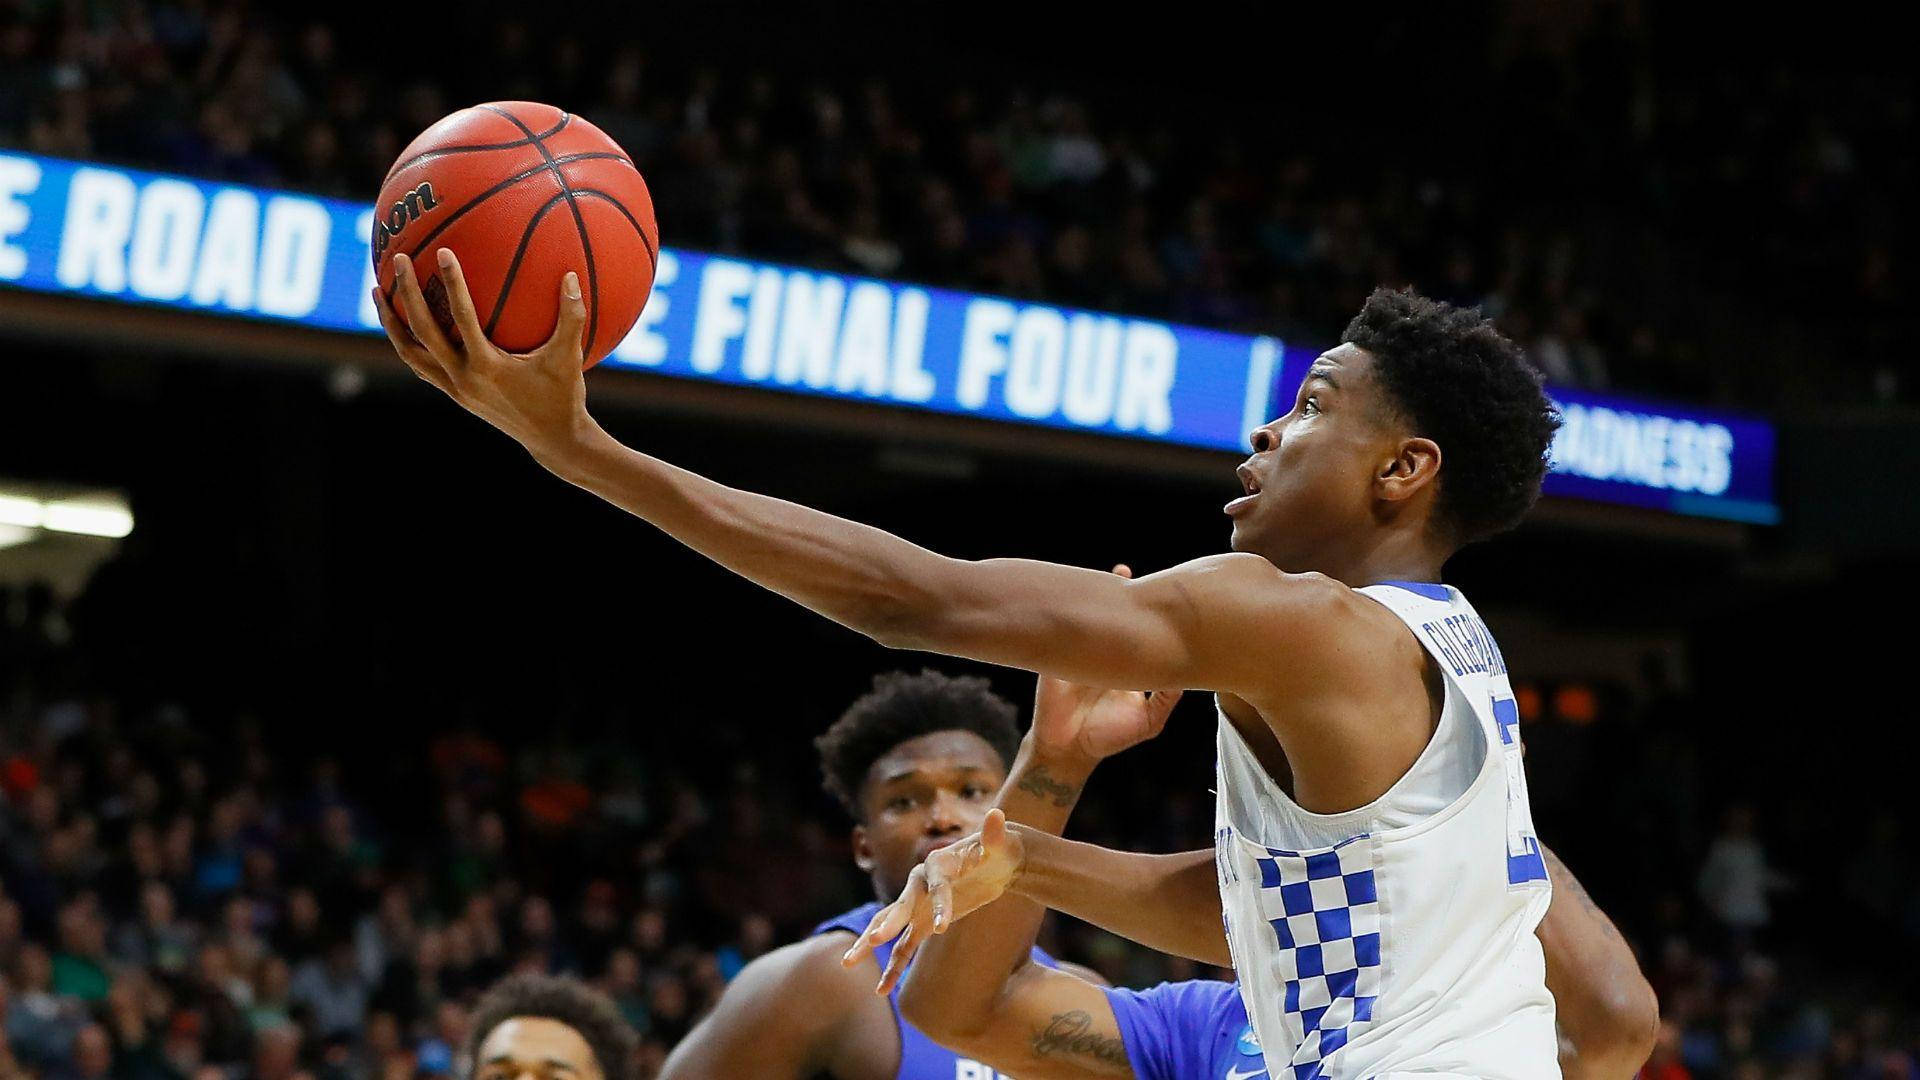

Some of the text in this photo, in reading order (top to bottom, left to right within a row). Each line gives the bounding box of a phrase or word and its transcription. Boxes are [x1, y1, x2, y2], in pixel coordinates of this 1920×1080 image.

[55, 166, 332, 318] ROAD
[691, 259, 936, 402] FINAL
[956, 298, 1179, 436] FOUR
[1546, 403, 1733, 496] ADNESS
